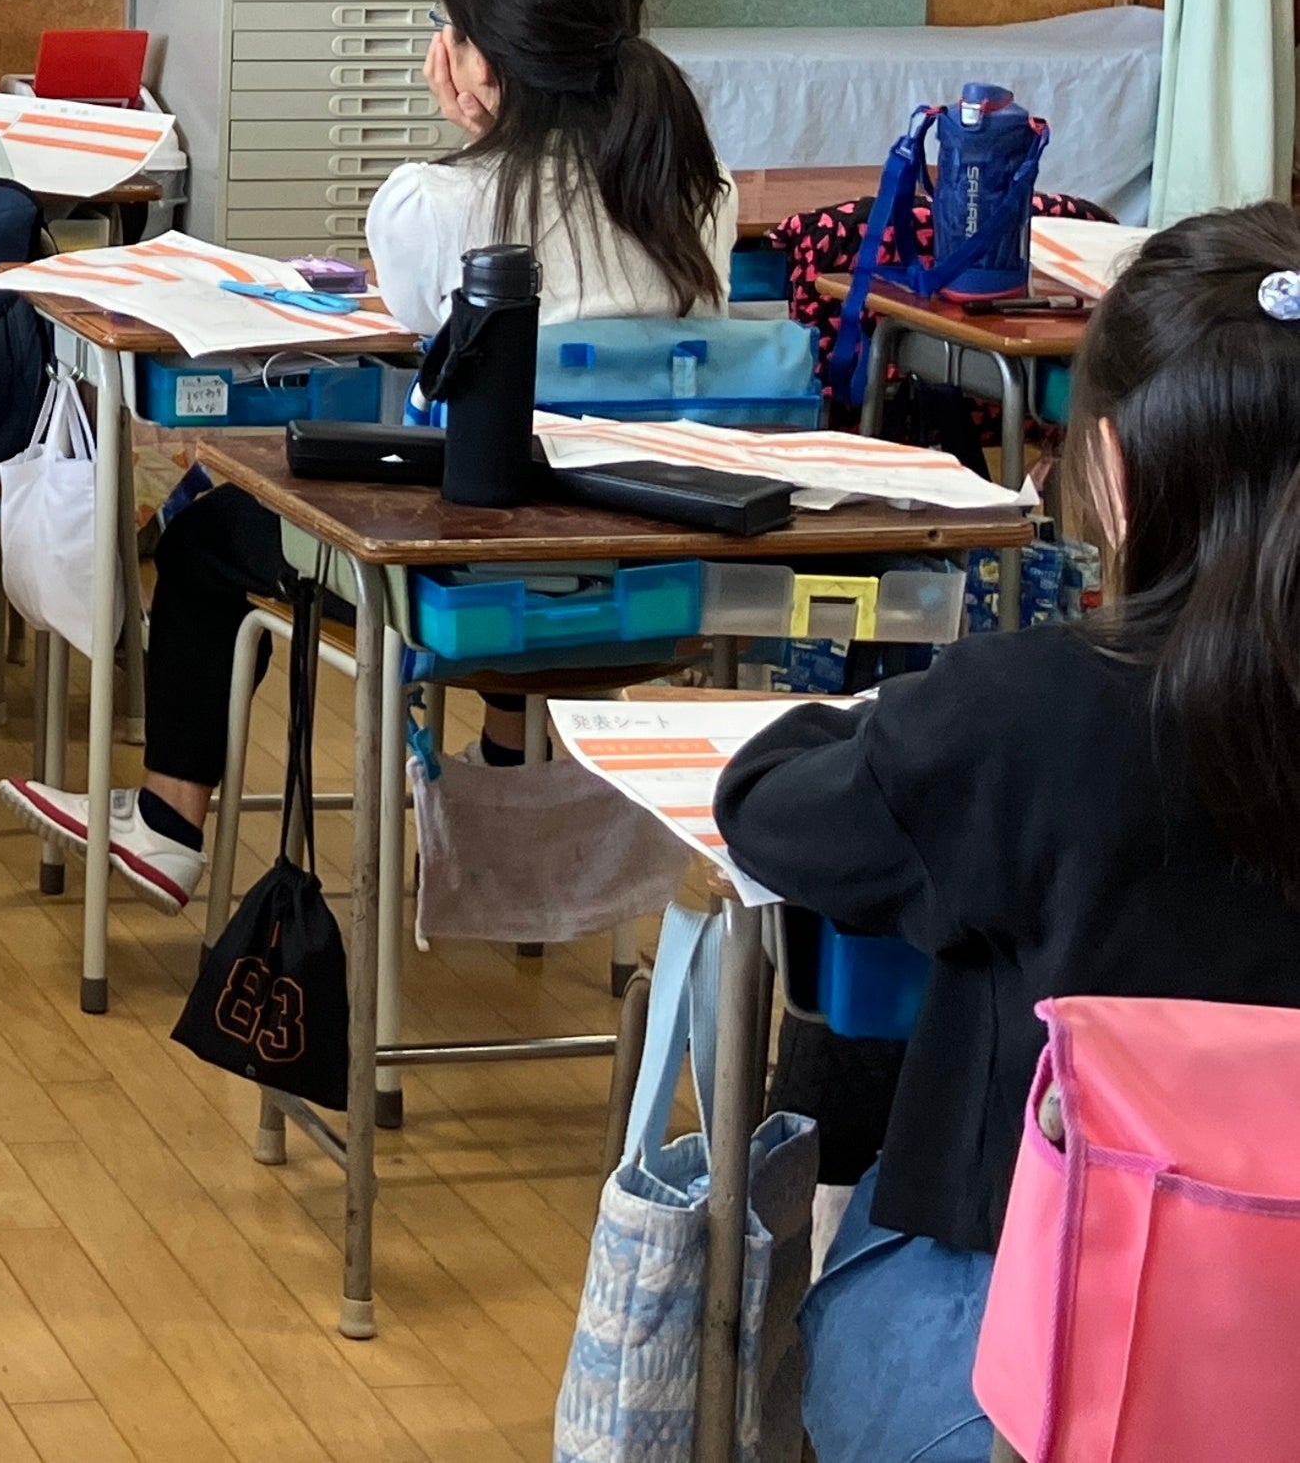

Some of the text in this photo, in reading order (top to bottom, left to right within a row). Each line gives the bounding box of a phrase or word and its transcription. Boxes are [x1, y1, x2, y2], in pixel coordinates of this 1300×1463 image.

[965, 165, 980, 239] SAHAR
[571, 714, 670, 730] 発表シート
